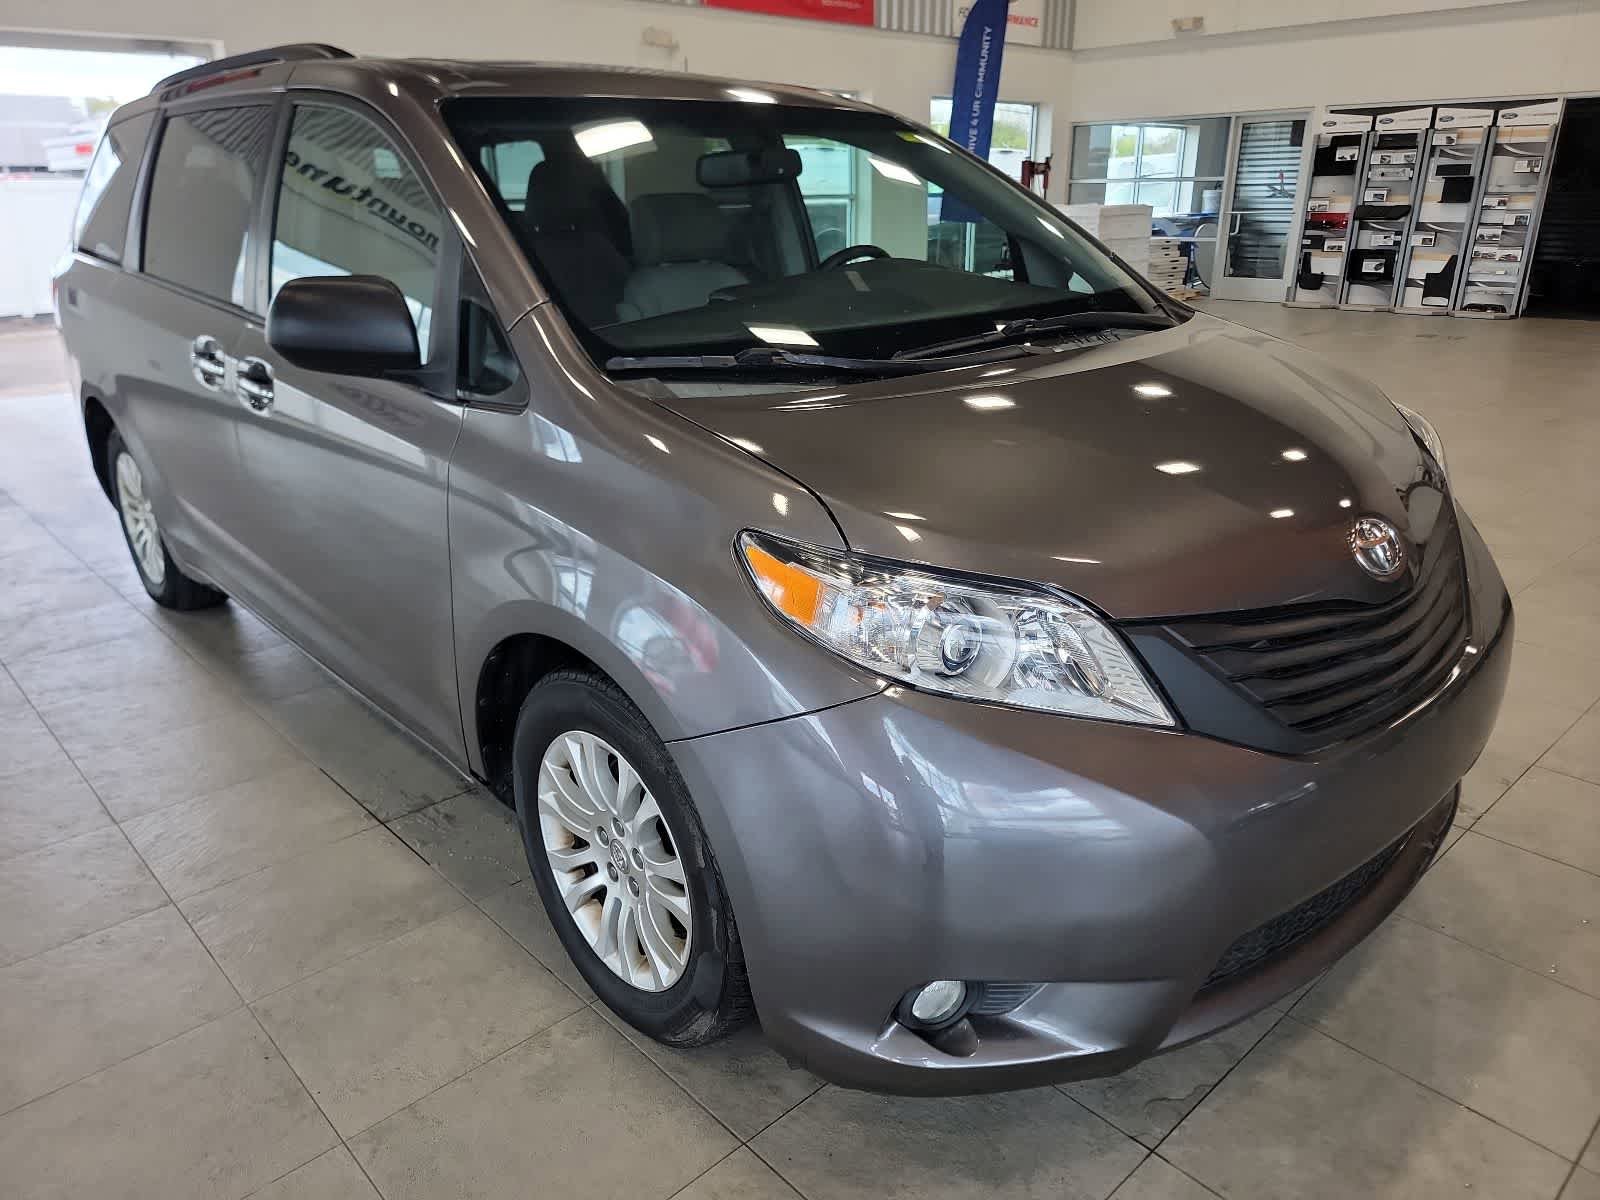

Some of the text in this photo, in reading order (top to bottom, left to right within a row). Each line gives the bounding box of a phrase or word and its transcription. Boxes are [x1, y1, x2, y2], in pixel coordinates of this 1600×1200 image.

[974, 25, 993, 98] COMMUNITY
[971, 101, 981, 117] UR
[970, 118, 979, 127] 4
